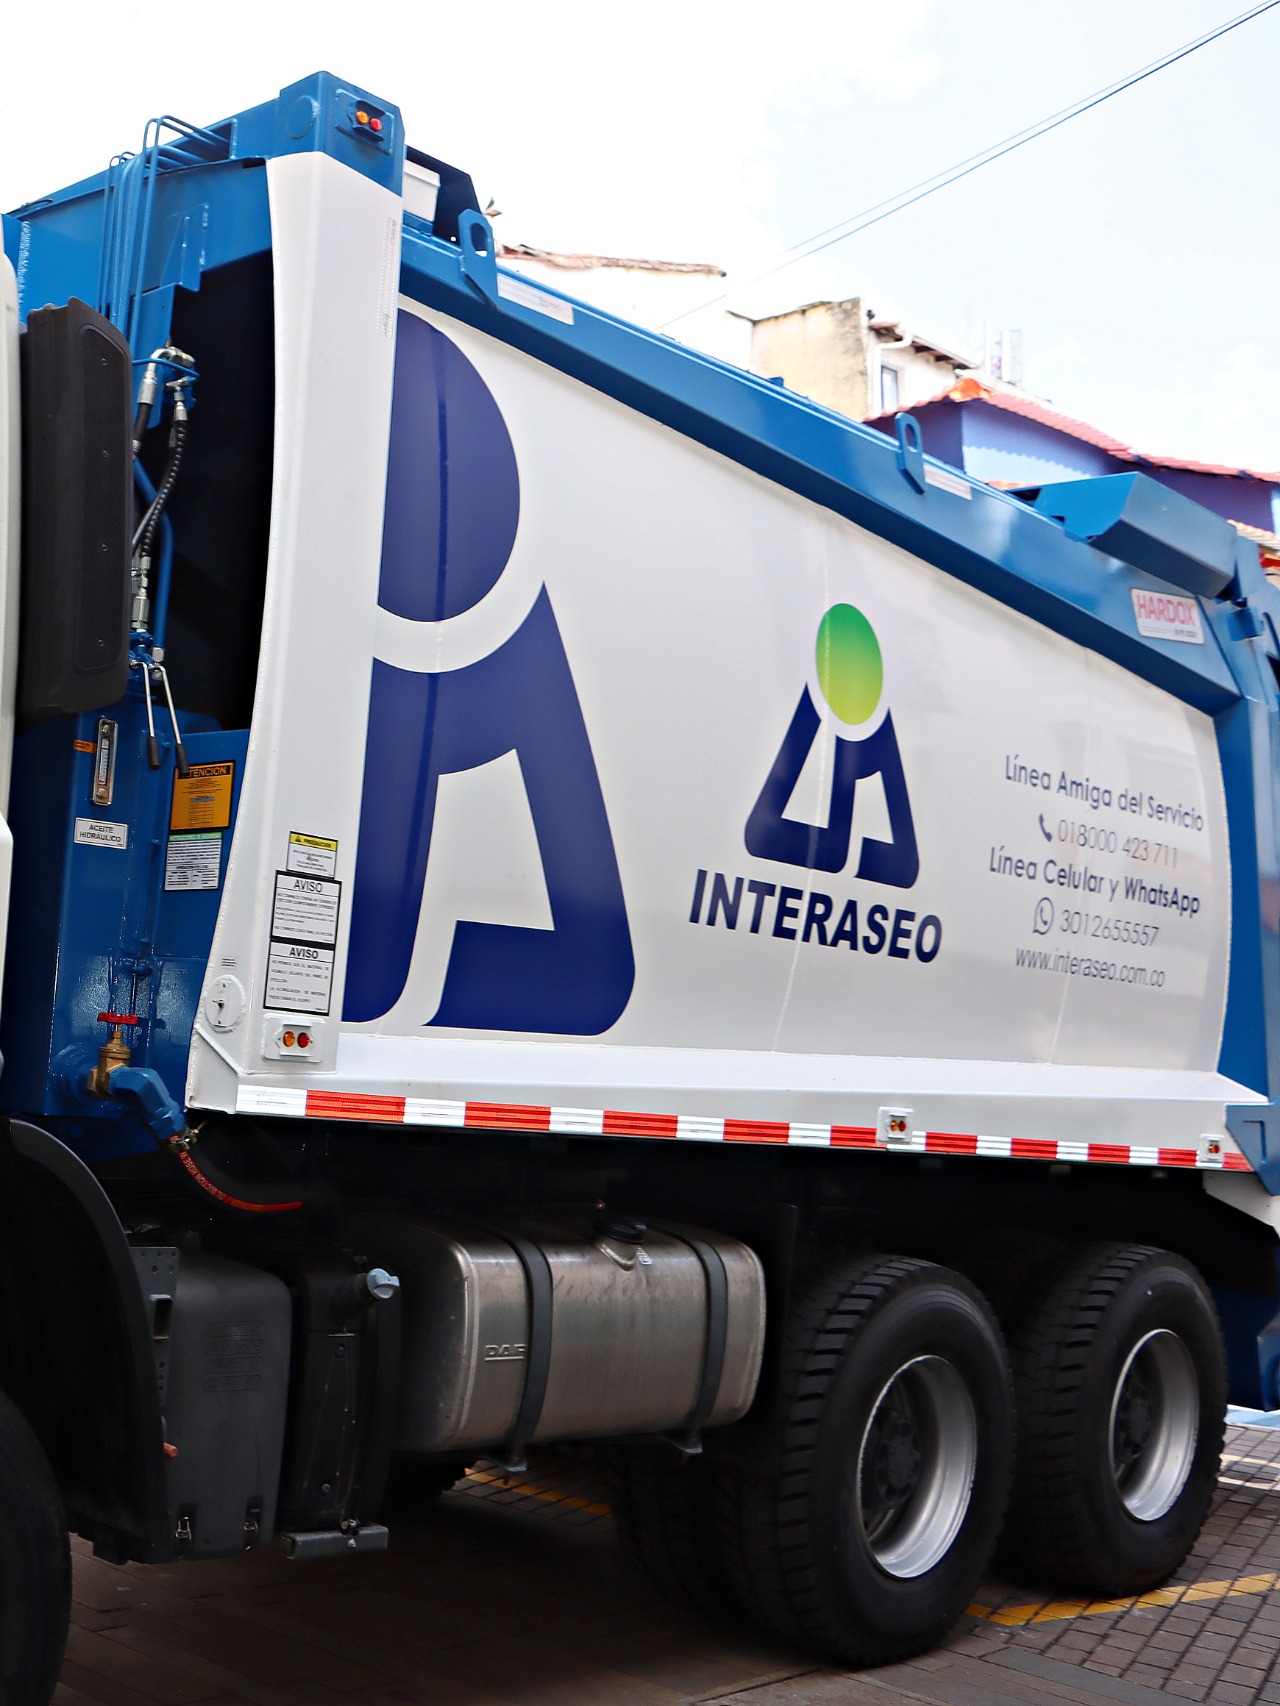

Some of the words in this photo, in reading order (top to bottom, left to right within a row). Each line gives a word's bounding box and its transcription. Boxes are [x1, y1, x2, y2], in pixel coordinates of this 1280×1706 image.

[1136, 594, 1196, 627] HARDOX
[186, 766, 227, 778] TENCION
[1005, 754, 1051, 790] Línea
[1057, 771, 1112, 810] Amiga
[1118, 788, 1143, 815] del
[1147, 795, 1204, 832] Servicio
[89, 824, 114, 834] ACEITE
[1058, 819, 1117, 853] 018000
[1122, 837, 1149, 861] 423
[1154, 842, 1178, 868] 711
[293, 879, 323, 893] AVISO
[989, 845, 1037, 881] Línea
[1043, 859, 1104, 893] Celular
[1109, 877, 1120, 903] y
[1124, 876, 1200, 919] WhatsApp
[689, 869, 942, 963] INTERASEO
[1060, 910, 1160, 946] 3012655557
[289, 947, 319, 960] AVISO
[1016, 948, 1166, 988] www.interaseo.com.co
